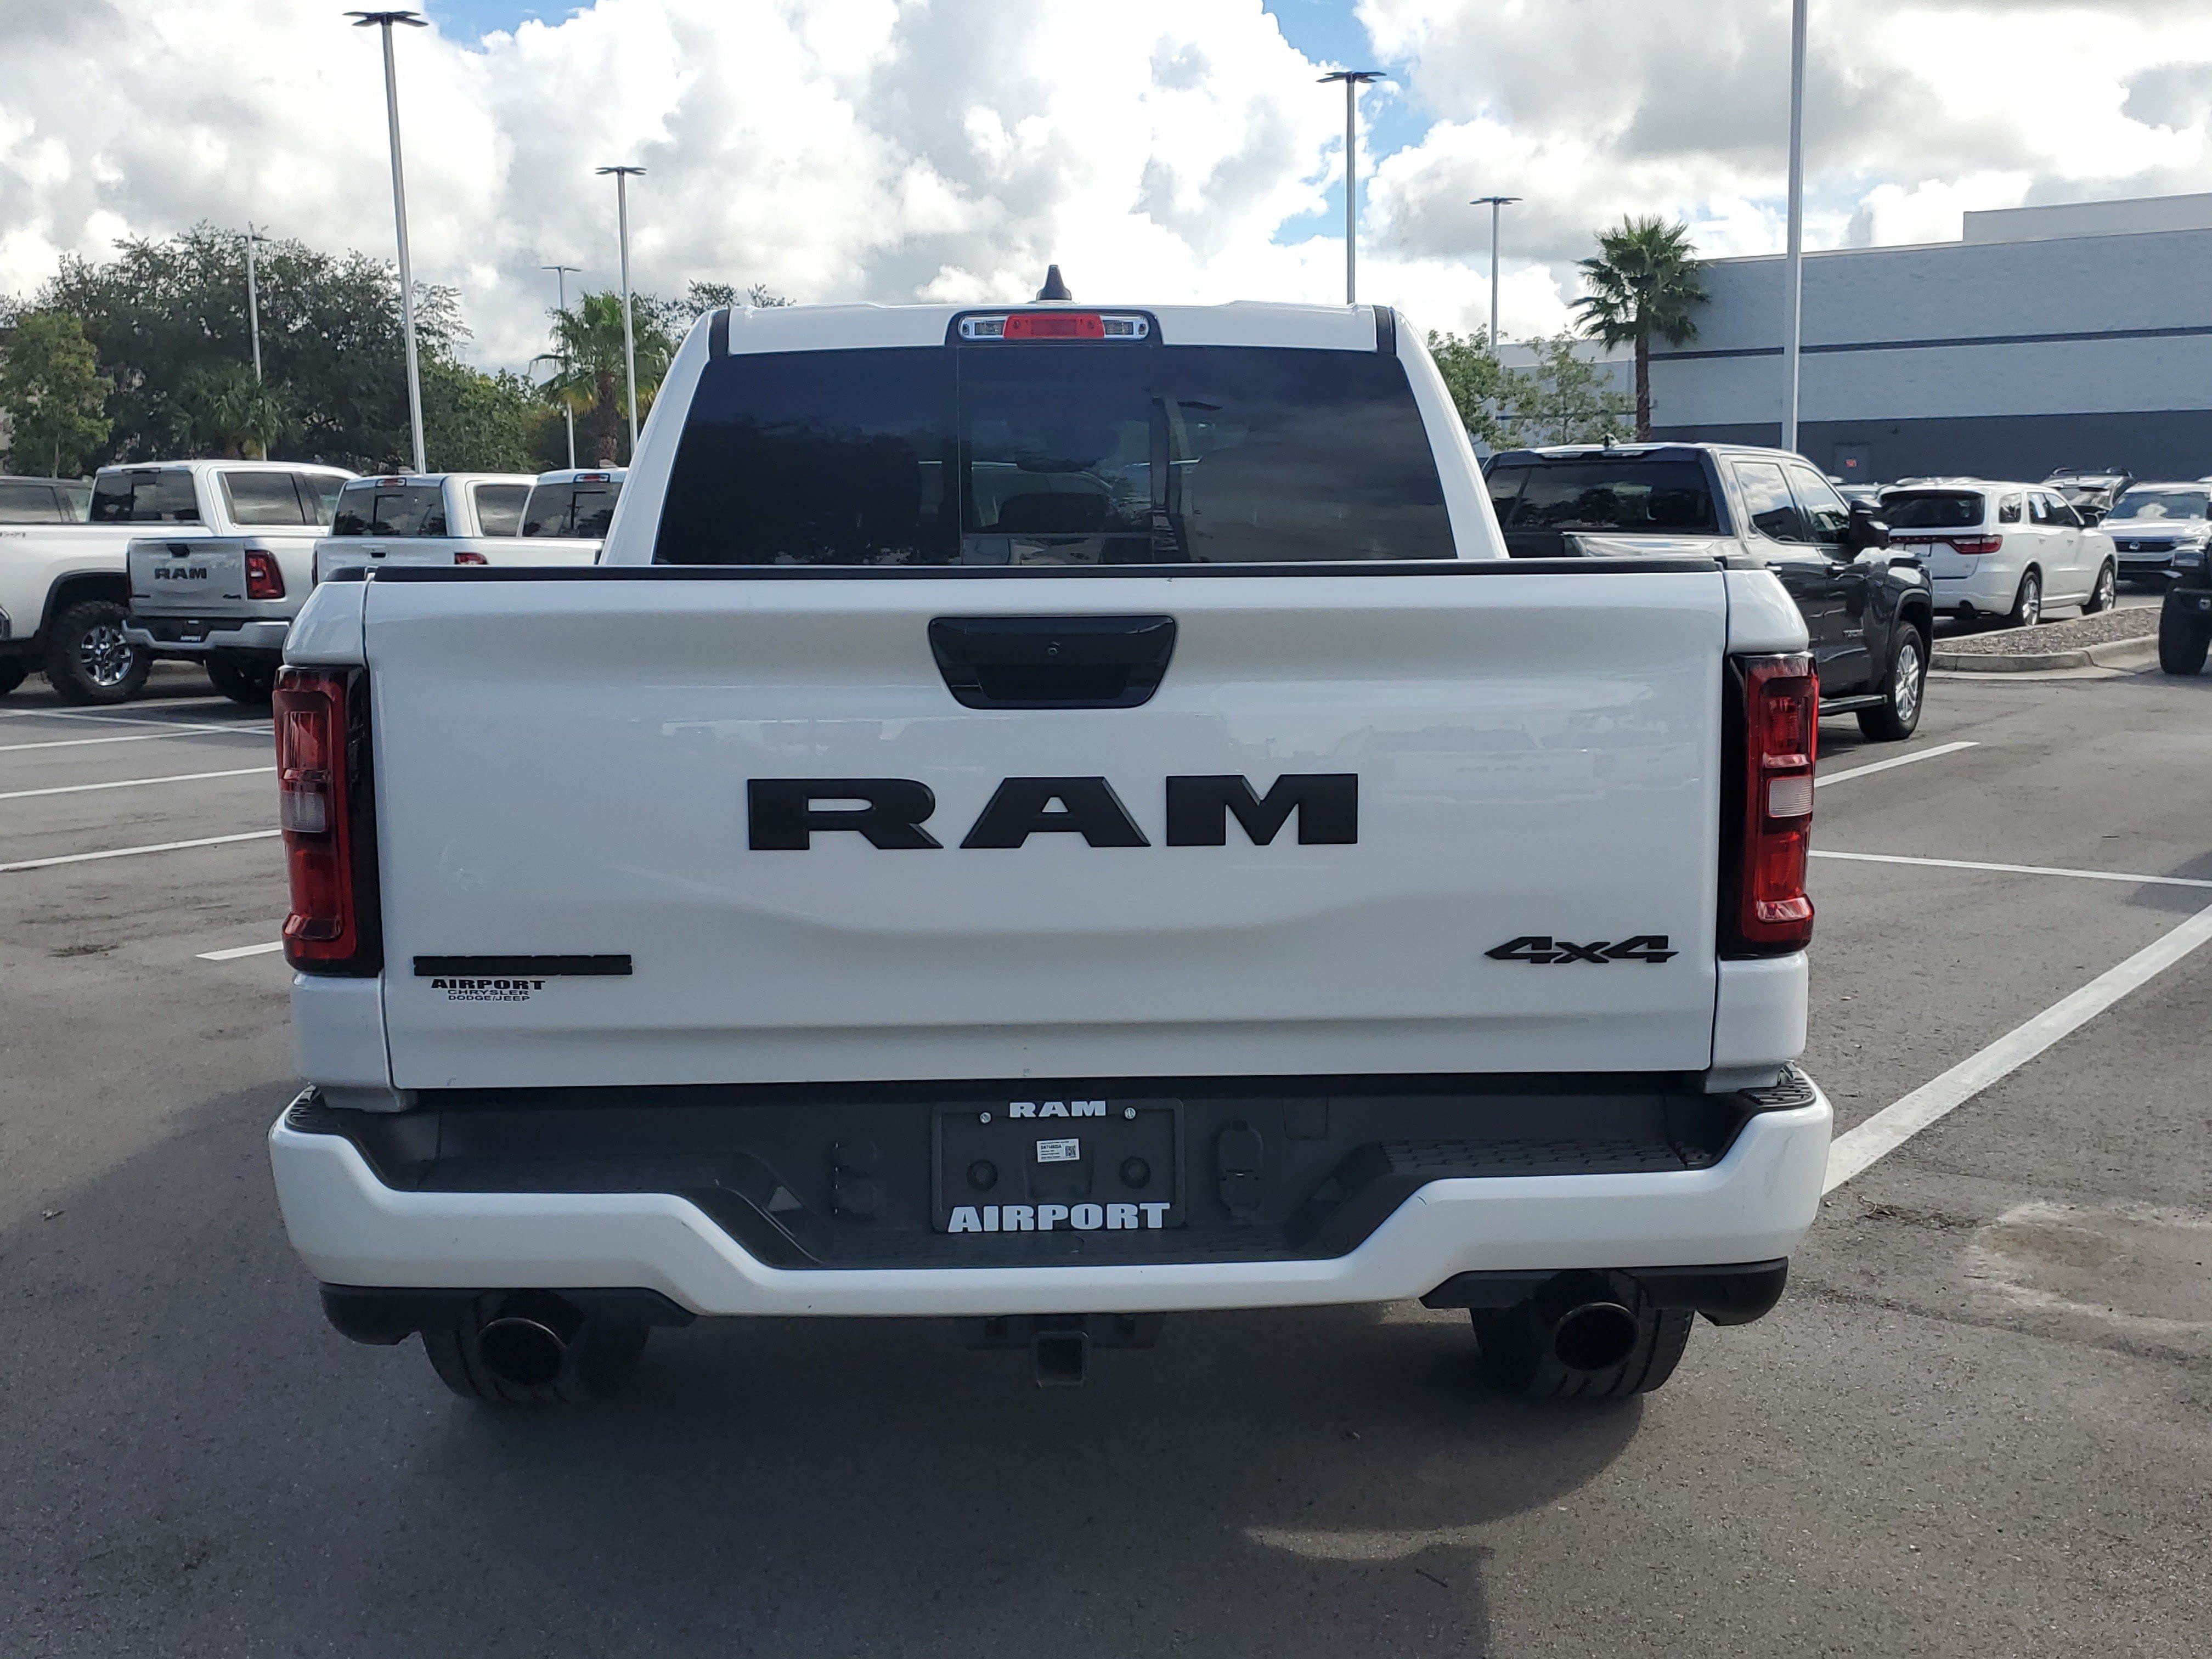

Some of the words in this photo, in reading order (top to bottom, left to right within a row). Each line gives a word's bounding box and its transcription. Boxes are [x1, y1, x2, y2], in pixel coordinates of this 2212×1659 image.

[155, 567, 207, 580] RAM
[747, 773, 1358, 850] RAM
[1484, 935, 1679, 964] 4x4
[431, 979, 545, 990] AIRPORT
[1009, 1101, 1106, 1118] RAM
[948, 1203, 1170, 1232] AIRPORT
